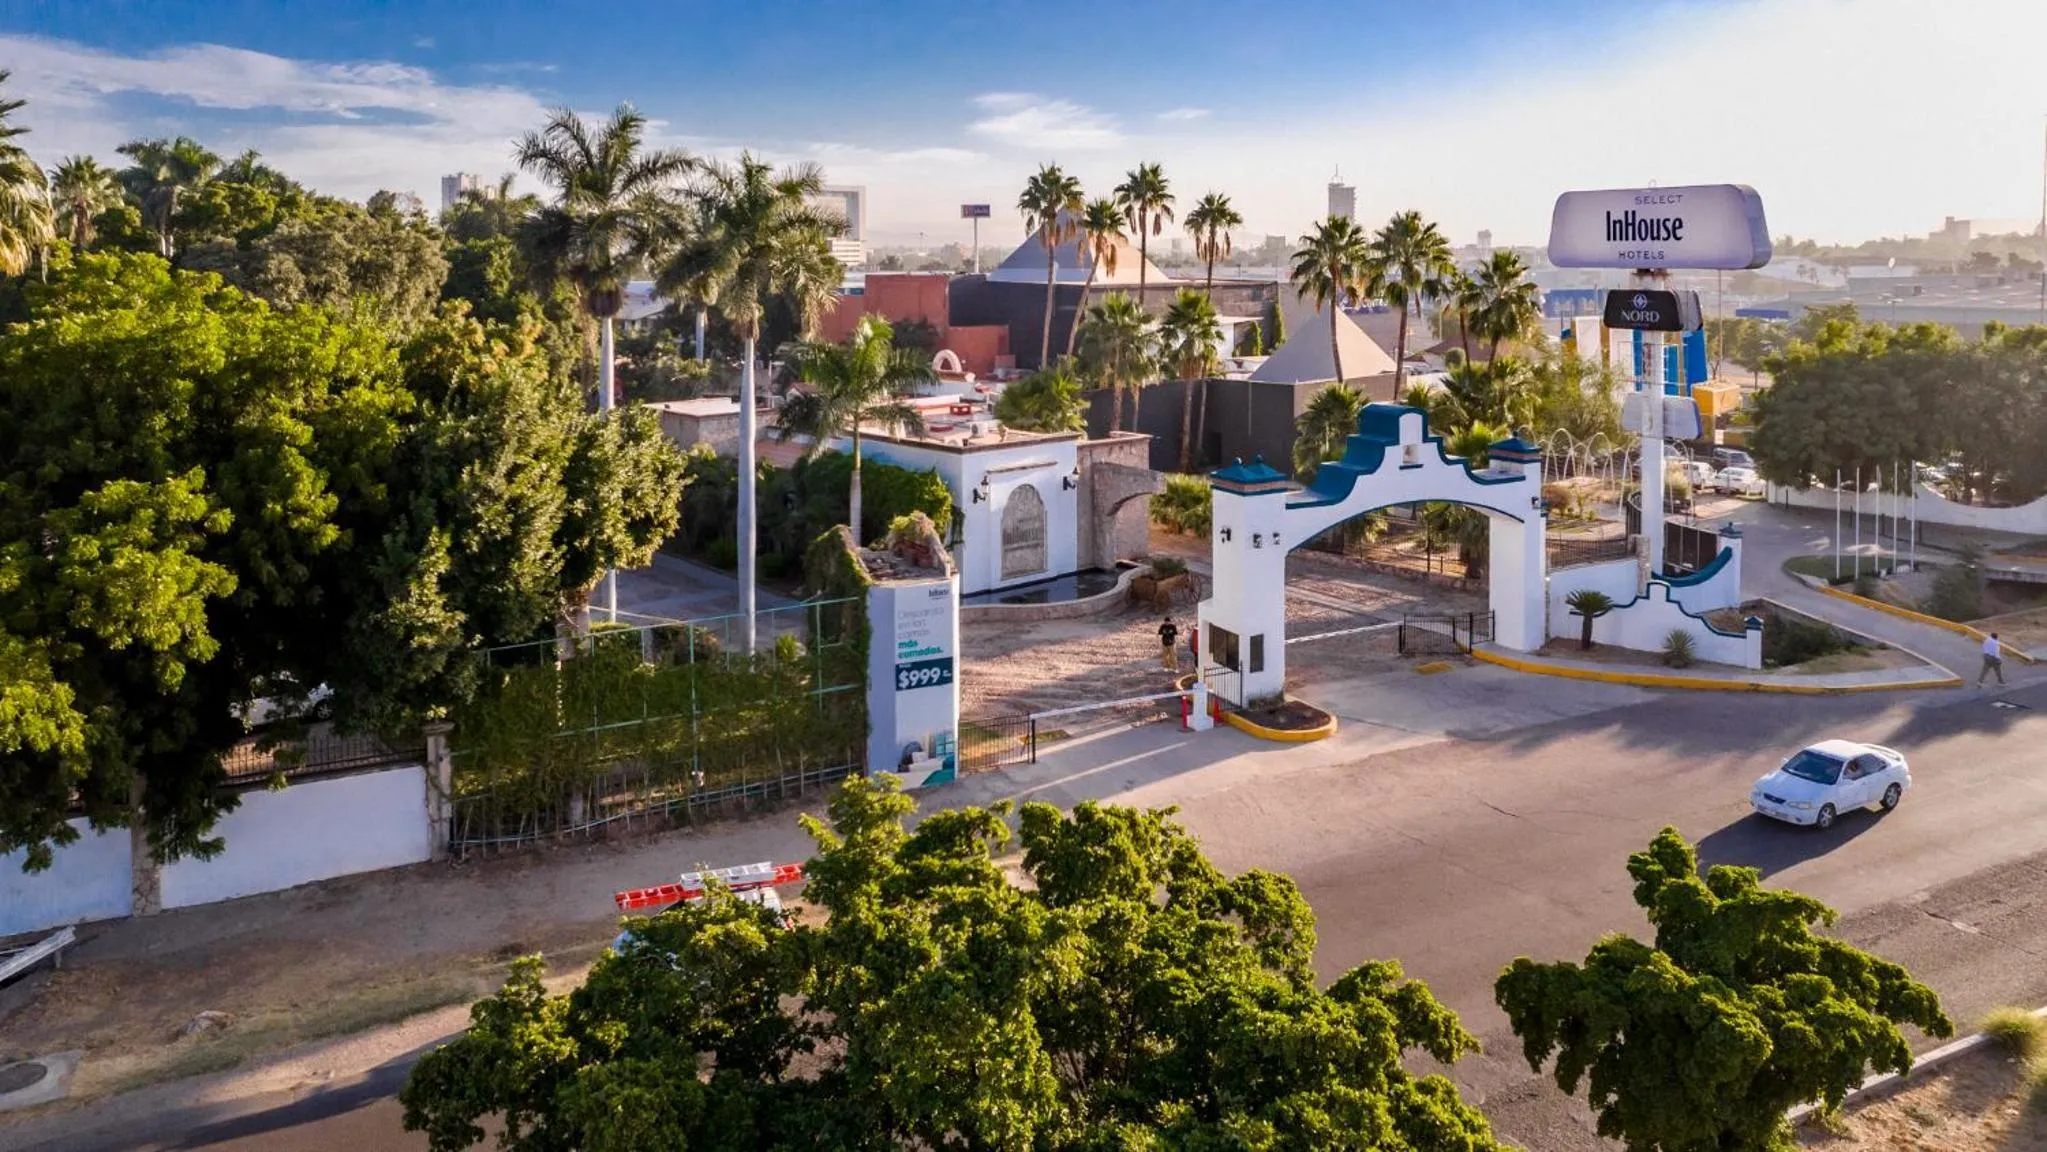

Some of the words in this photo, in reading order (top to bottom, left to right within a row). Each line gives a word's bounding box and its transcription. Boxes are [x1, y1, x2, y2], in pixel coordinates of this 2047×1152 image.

[1635, 195, 1683, 205] SELECT
[1606, 210, 1683, 241] InHouse
[1618, 250, 1665, 259] HOTELS
[1621, 310, 1660, 322] NORD
[898, 667, 941, 689] $999
